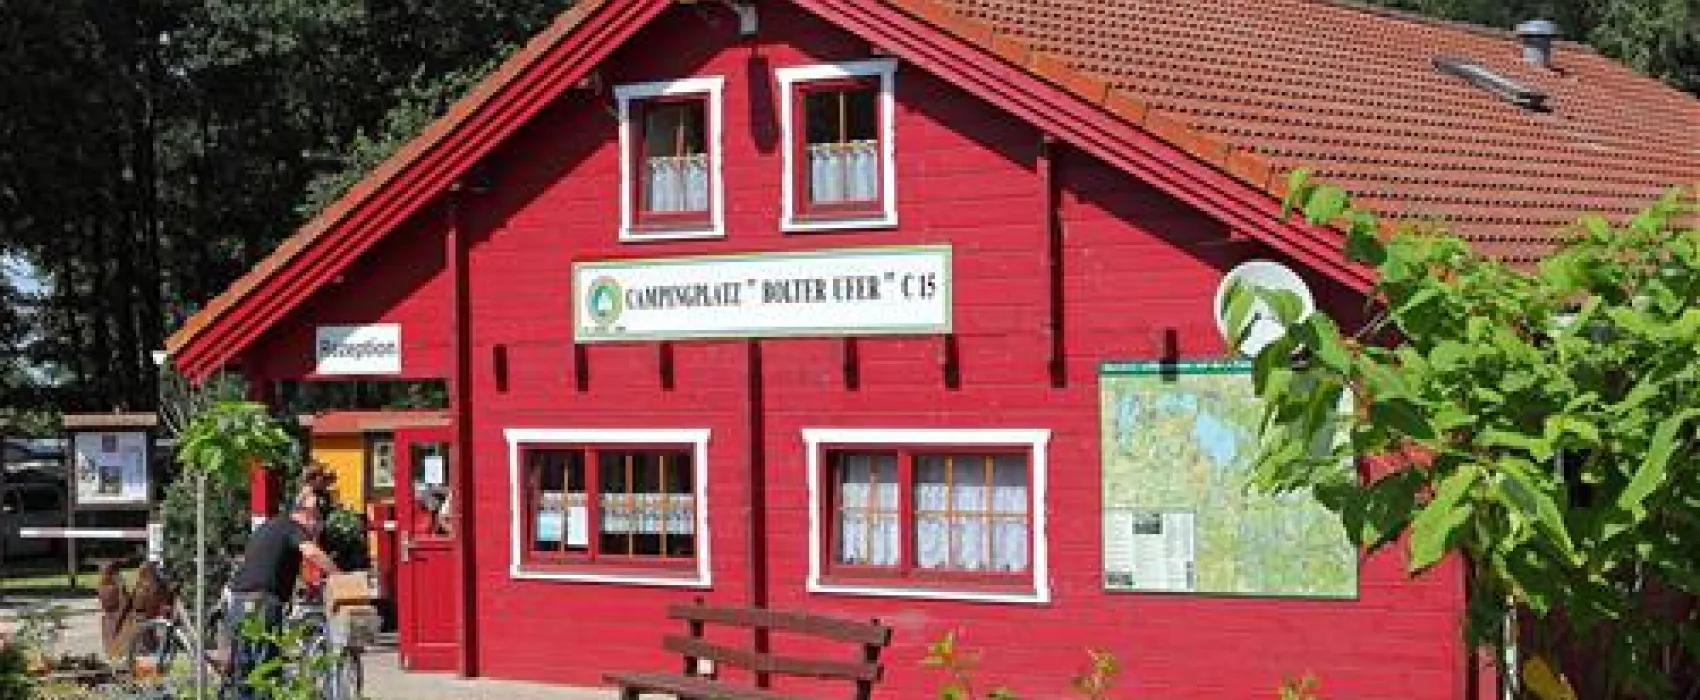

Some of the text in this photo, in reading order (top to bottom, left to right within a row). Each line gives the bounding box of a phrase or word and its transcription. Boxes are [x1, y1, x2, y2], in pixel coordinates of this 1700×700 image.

[625, 281, 742, 311] CAMPINGPLATZ
[761, 277, 827, 304] BOLTER
[832, 274, 882, 304] UFER
[319, 339, 396, 361] Reception
